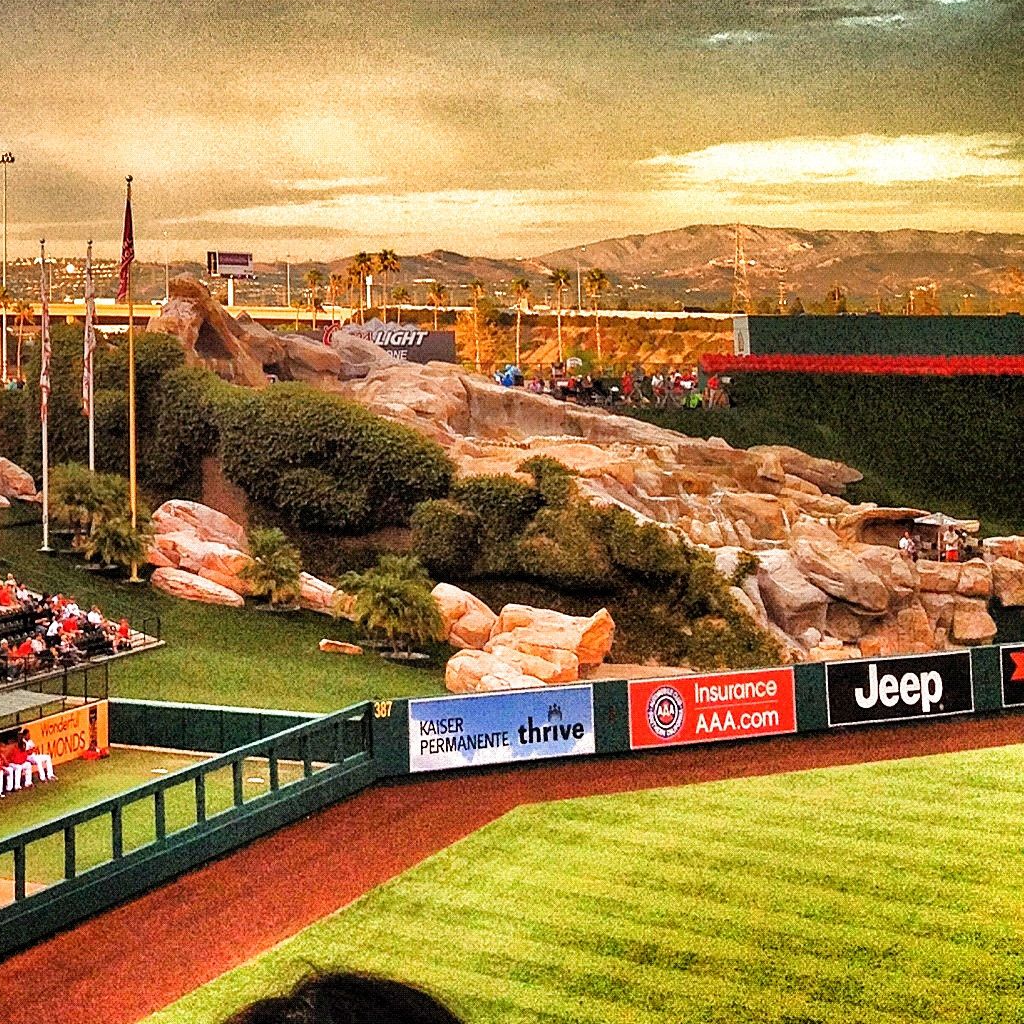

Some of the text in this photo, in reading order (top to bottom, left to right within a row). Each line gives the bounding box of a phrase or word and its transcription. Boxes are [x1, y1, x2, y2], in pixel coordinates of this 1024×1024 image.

[376, 329, 428, 346] LIGHT
[387, 349, 408, 360] ONE
[694, 680, 777, 703] Insurance
[855, 663, 943, 713] Jeep
[374, 701, 393, 718] 387
[420, 718, 463, 736] KAISER
[518, 717, 585, 745] thrive
[695, 710, 779, 734] AAA.com
[420, 731, 509, 755] PERMANENTE
